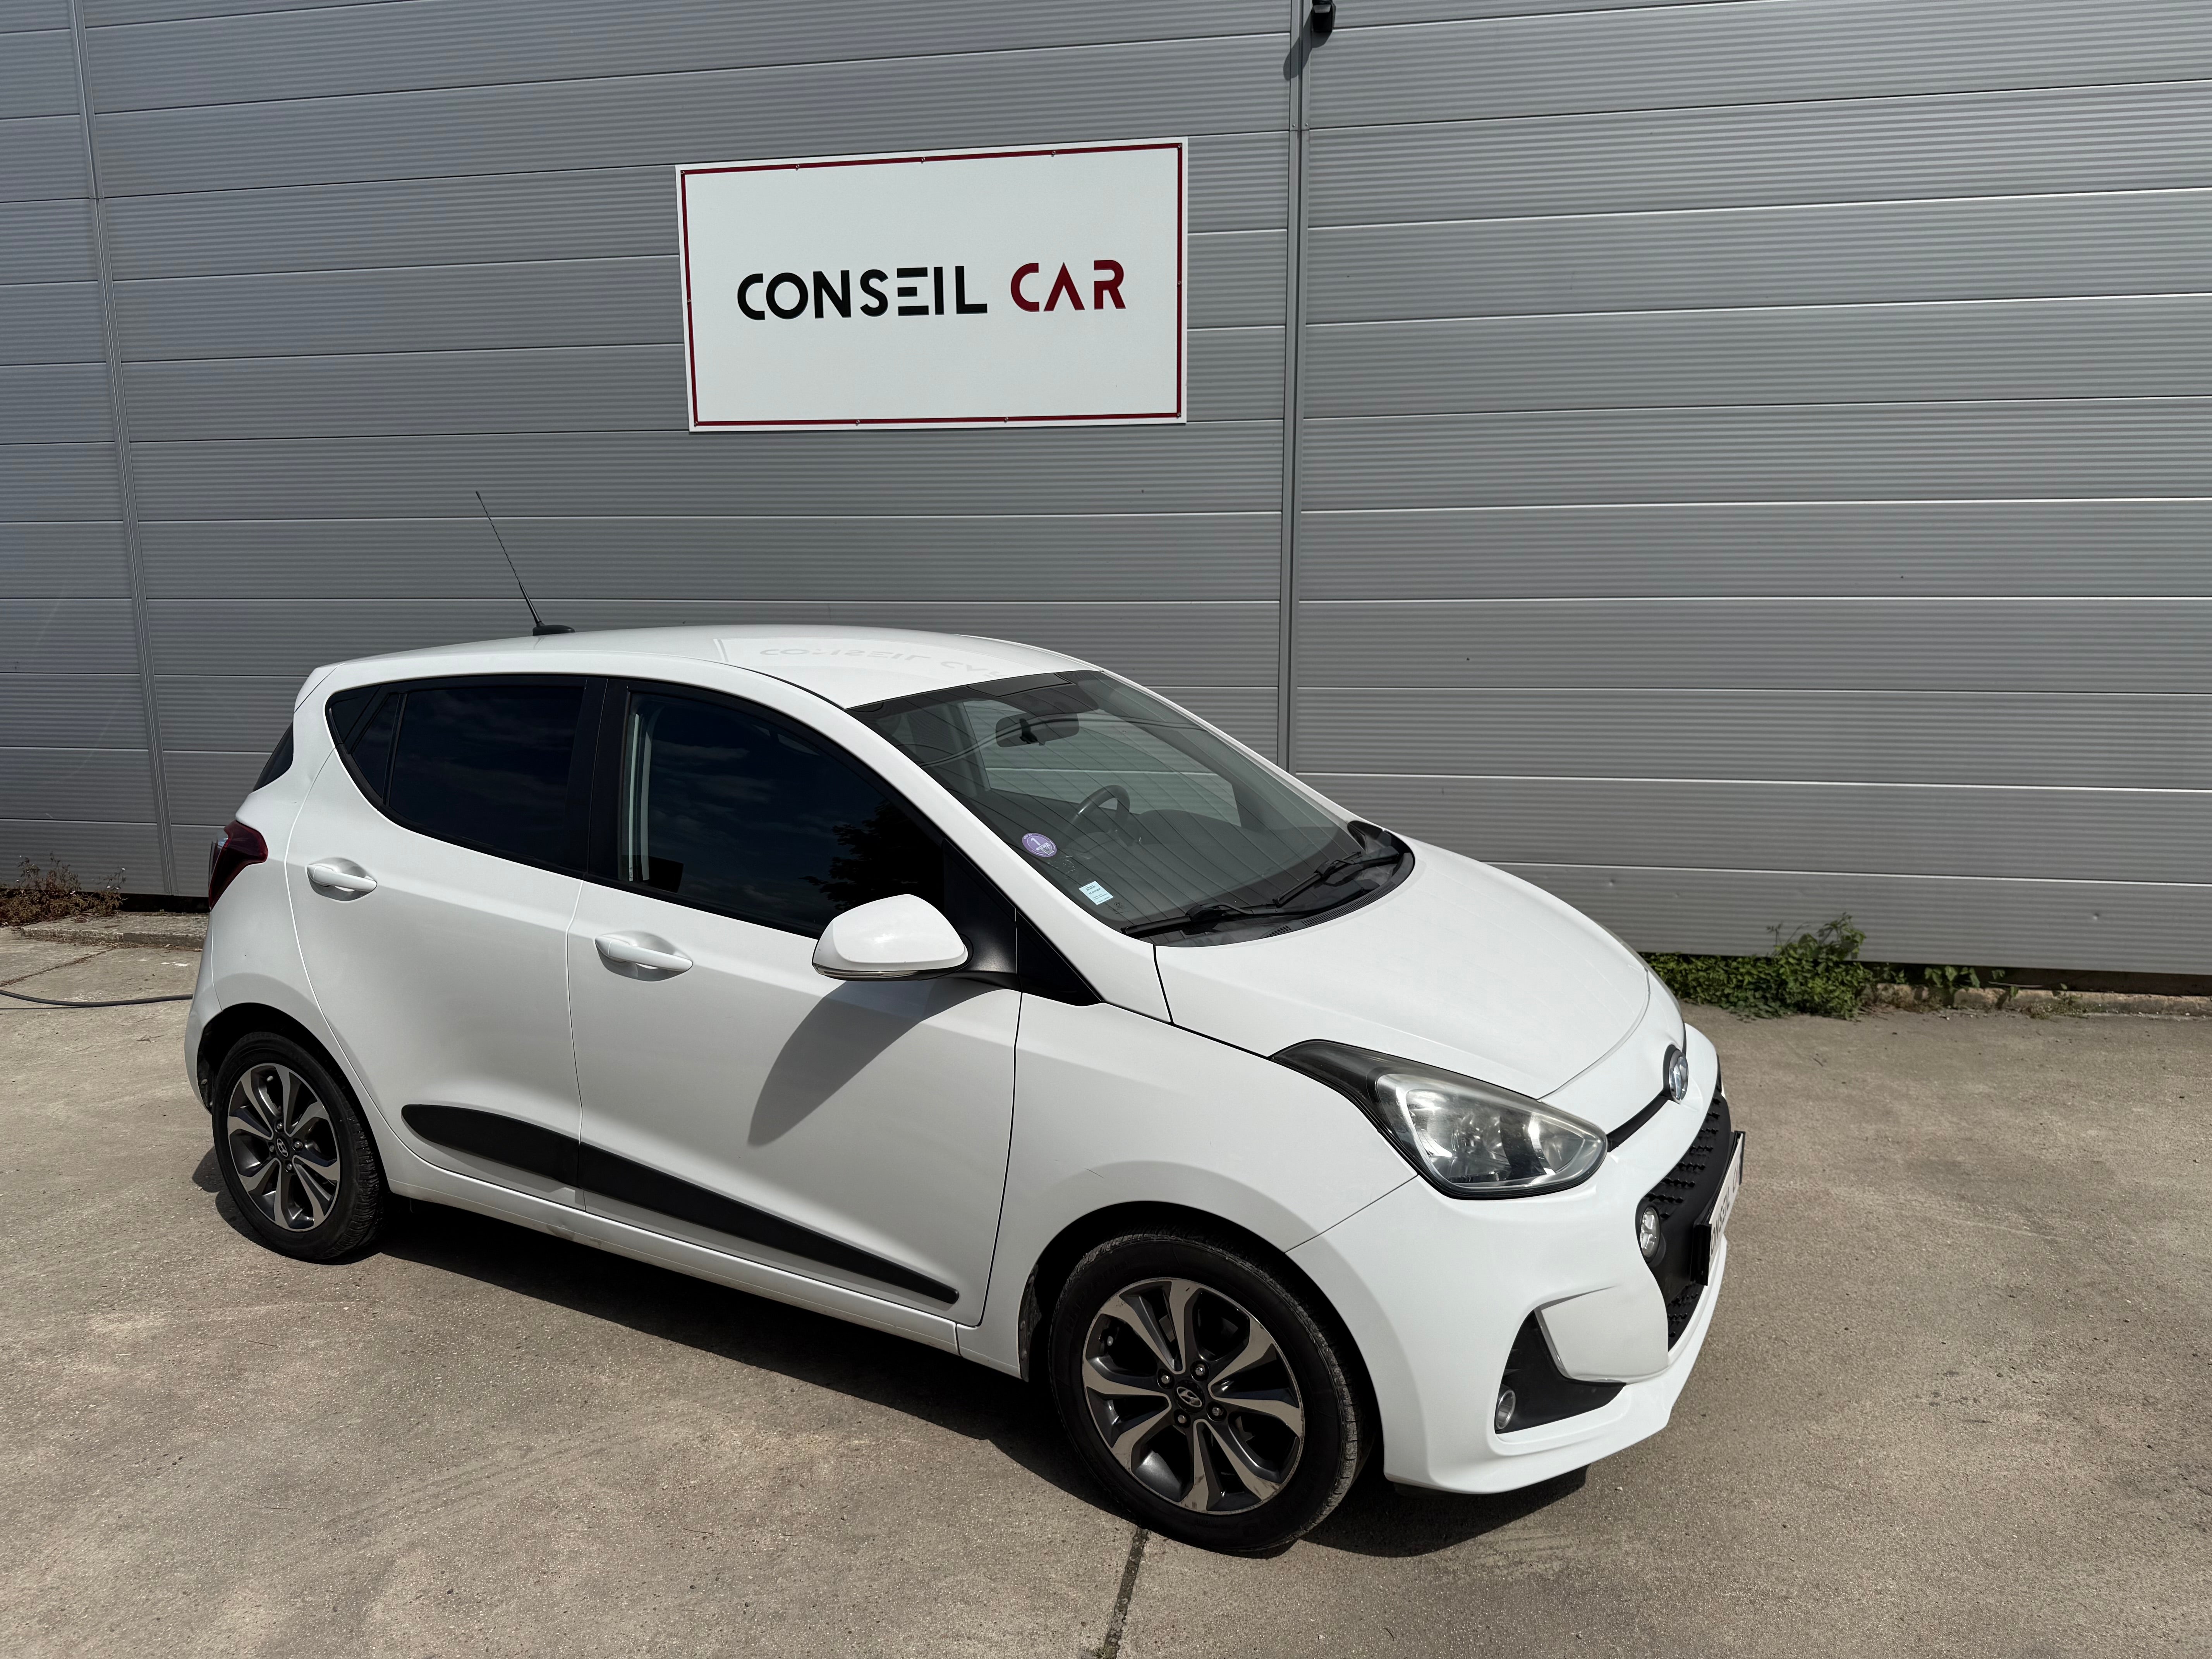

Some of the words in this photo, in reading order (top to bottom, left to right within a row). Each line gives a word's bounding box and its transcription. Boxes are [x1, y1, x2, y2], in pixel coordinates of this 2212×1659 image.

[737, 266, 988, 320] CONSEIL
[1010, 259, 1126, 312] CAR
[1030, 837, 1041, 846] 1
[1711, 1186, 1730, 1256] ONSEIL
